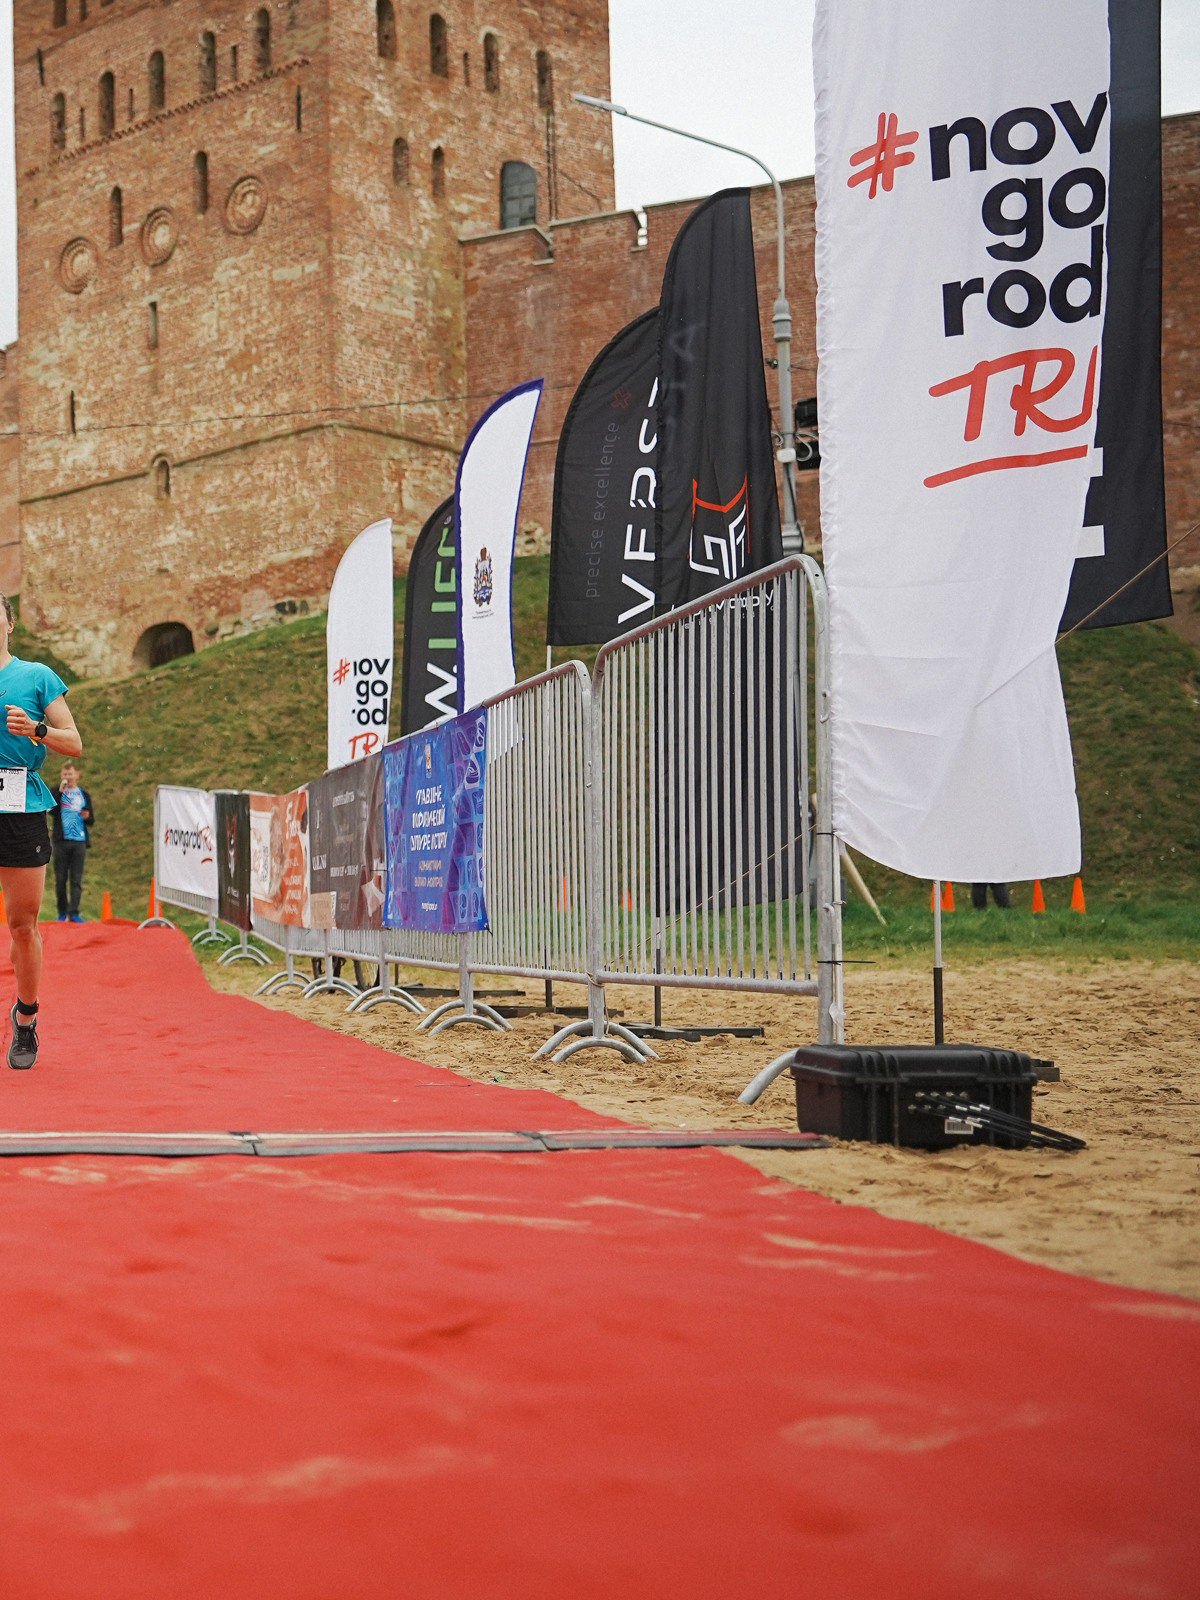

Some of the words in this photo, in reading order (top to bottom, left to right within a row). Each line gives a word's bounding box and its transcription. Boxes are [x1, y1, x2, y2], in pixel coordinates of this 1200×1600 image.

[847, 90, 1108, 199] #nov
[981, 166, 1106, 262] go
[942, 223, 1104, 337] rod
[928, 347, 1098, 442] TRI
[356, 679, 389, 705] go
